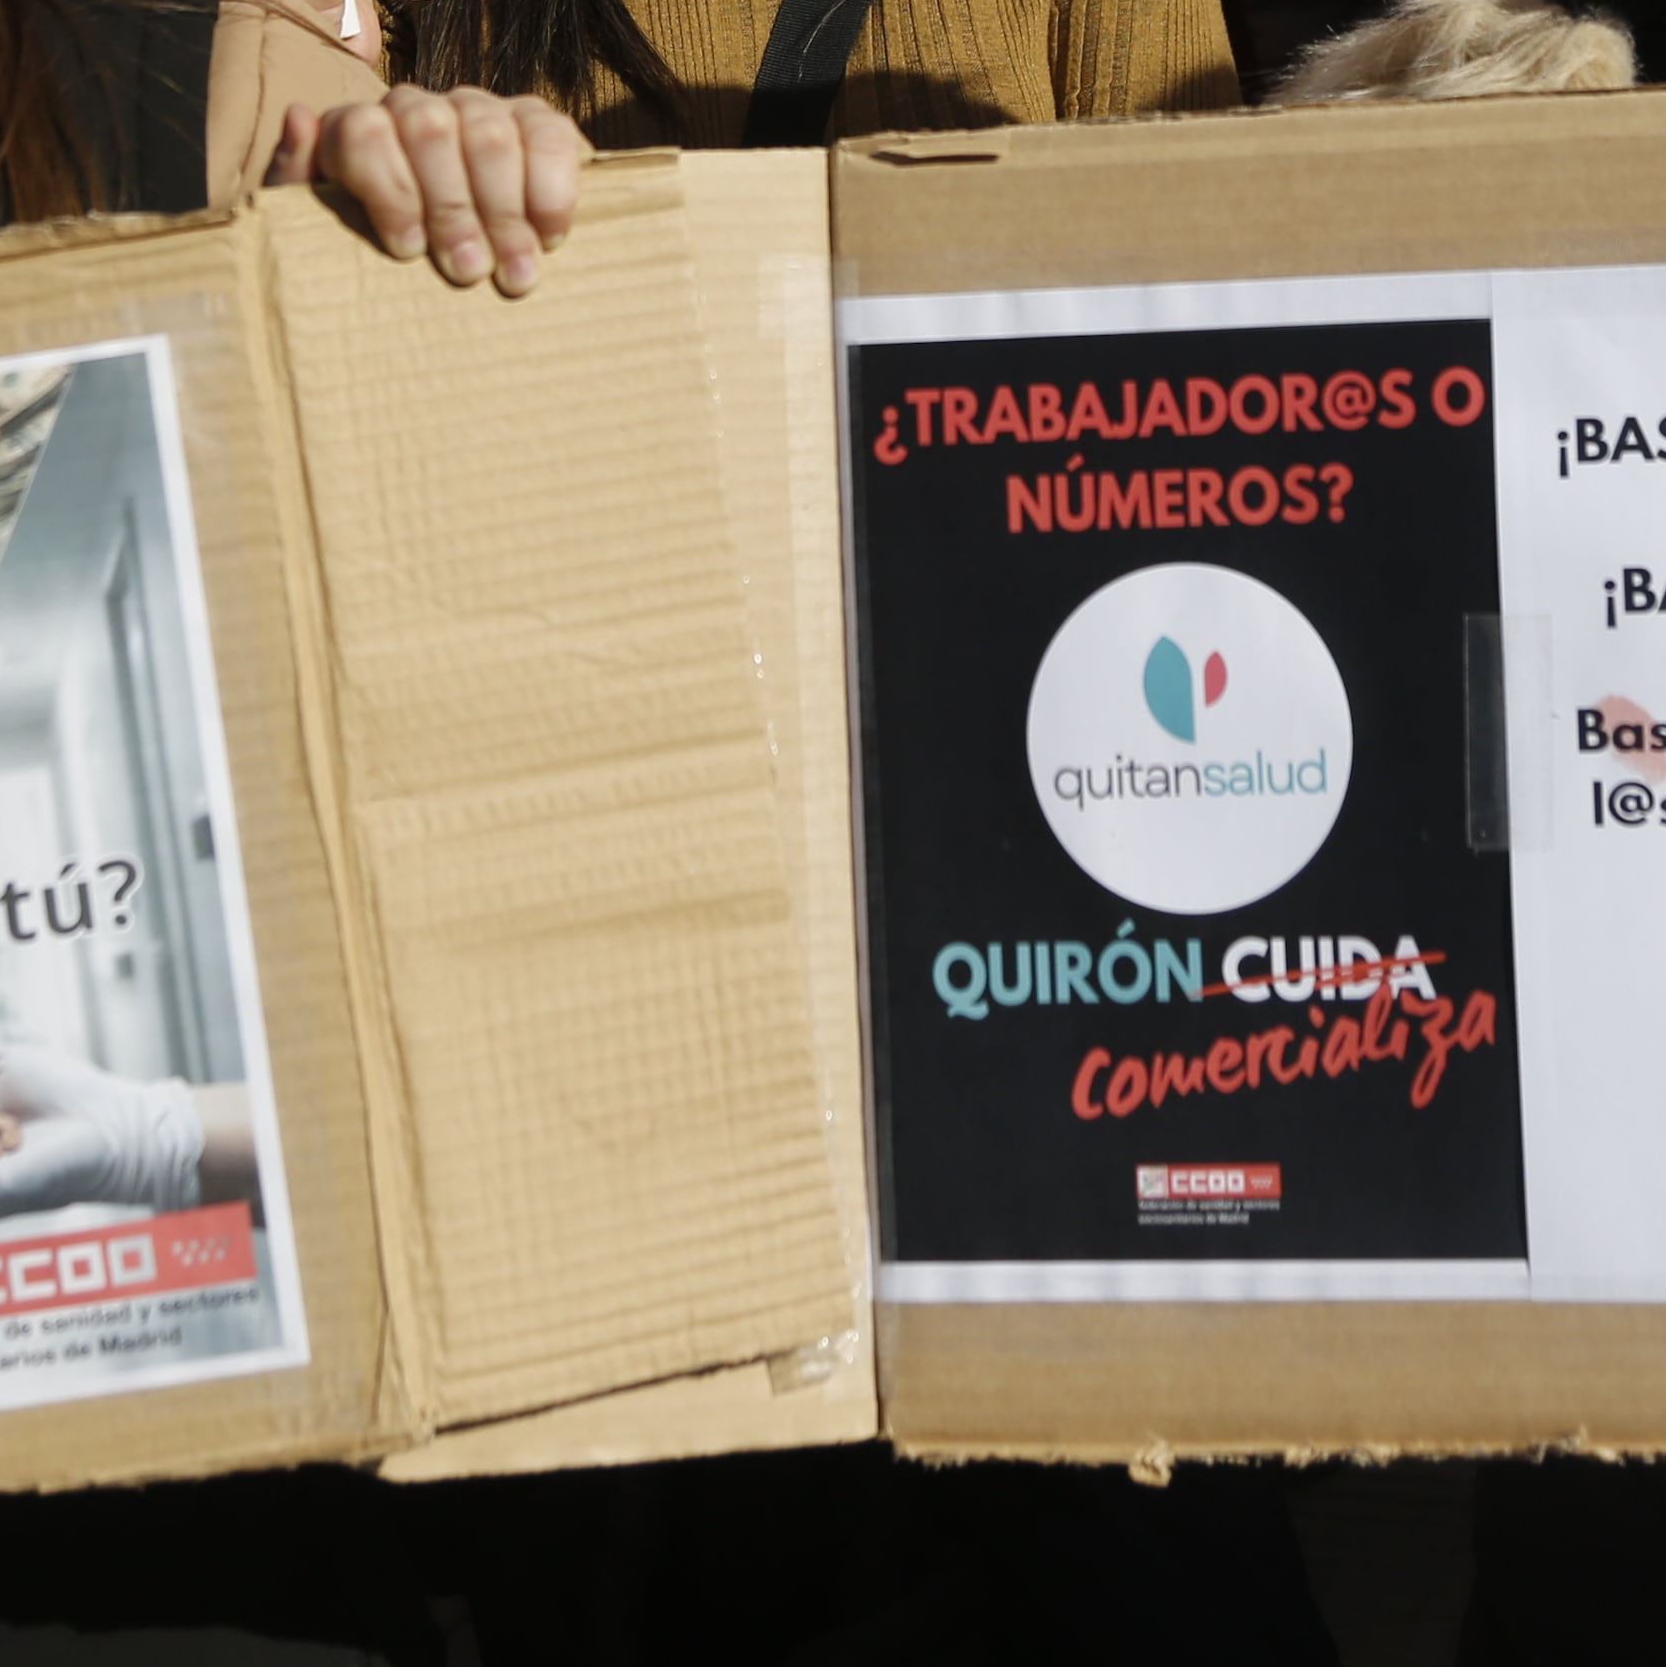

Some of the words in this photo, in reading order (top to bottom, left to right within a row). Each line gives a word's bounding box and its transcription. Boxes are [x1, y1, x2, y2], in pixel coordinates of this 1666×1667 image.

[874, 369, 1416, 467] ¿TRABAJADOR@S
[1432, 366, 1486, 426] O
[1007, 454, 1354, 533] NÚMEROS?
[1054, 749, 1328, 811] quitansalud
[933, 920, 1202, 1020] QUIRÓN
[1222, 937, 1435, 1002] CUIDA
[1072, 982, 1497, 1120] comercializa
[1171, 1169, 1245, 1194] CCOO
